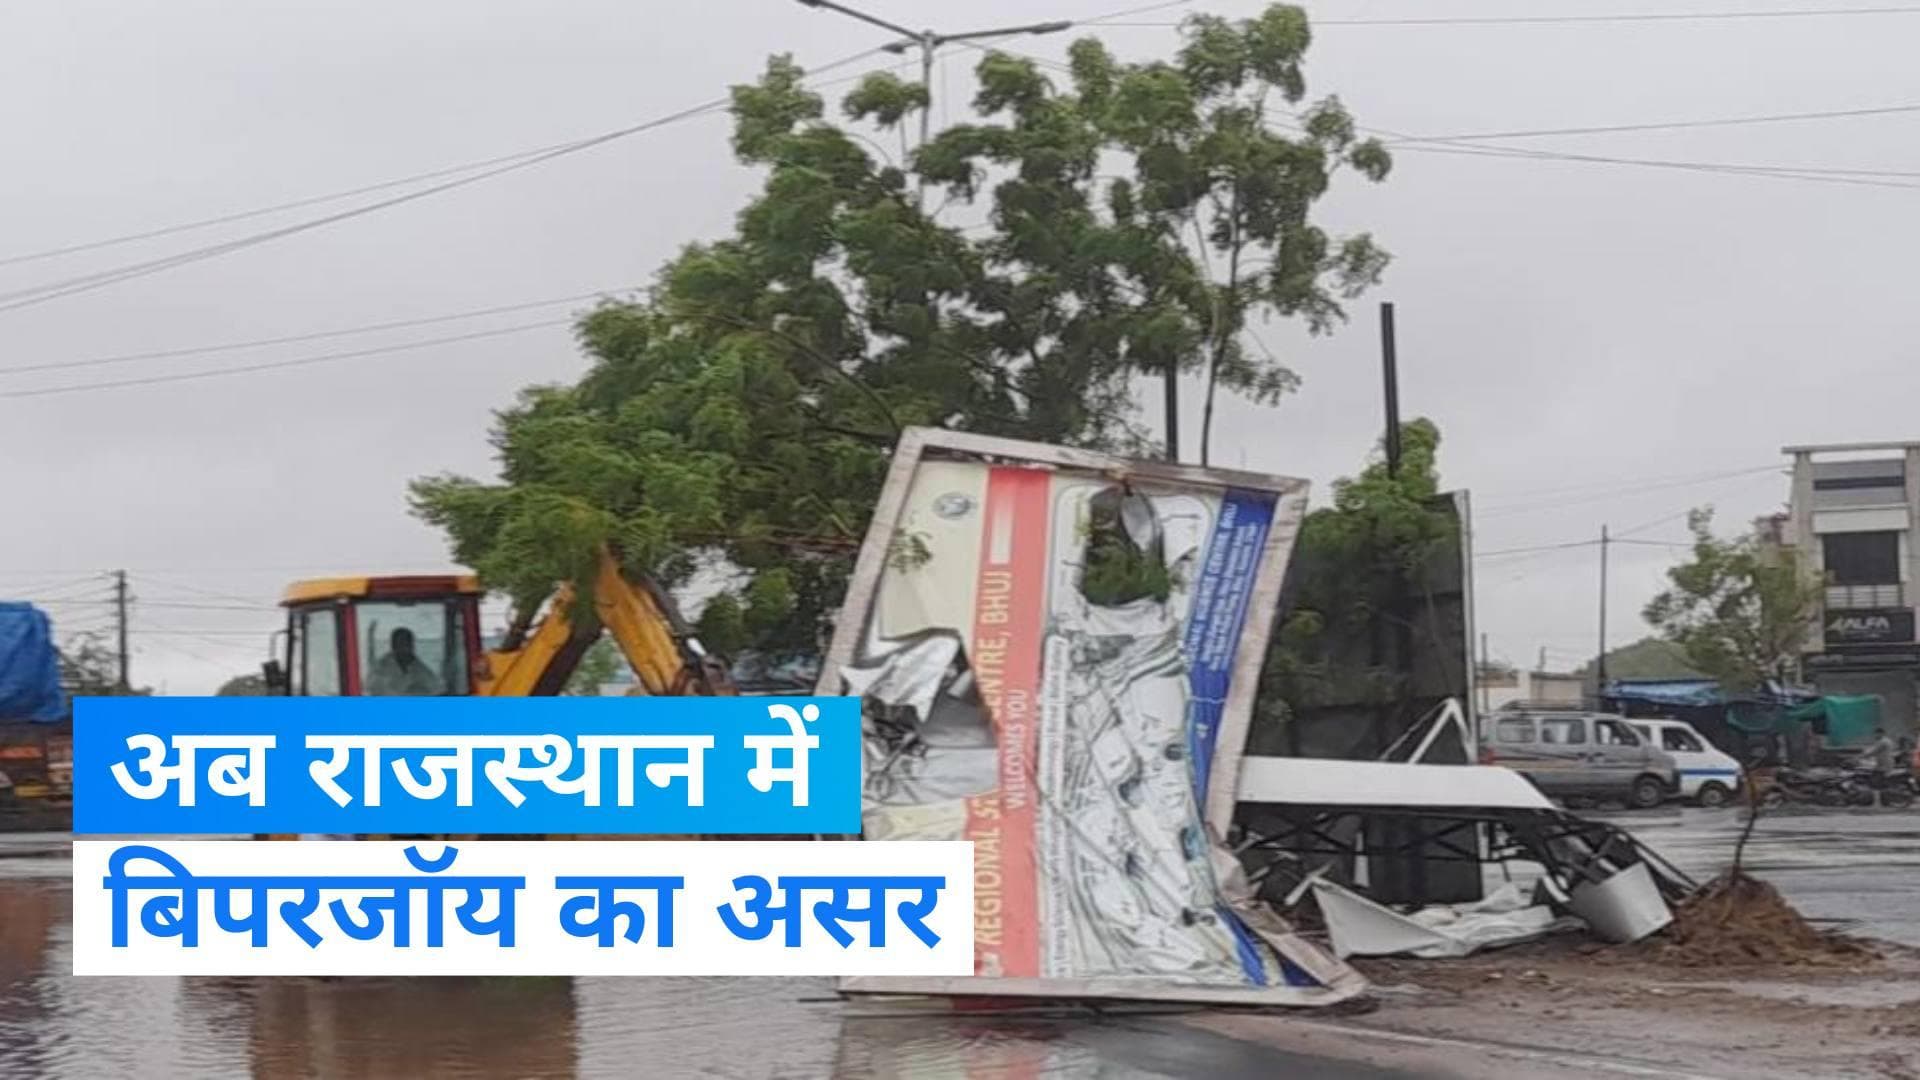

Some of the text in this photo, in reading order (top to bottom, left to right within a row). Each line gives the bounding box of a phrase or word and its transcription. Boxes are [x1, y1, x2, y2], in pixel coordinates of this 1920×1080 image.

[980, 570, 1013, 625] BHUJ
[1003, 688, 1028, 810] WELCOMES YOU
[970, 827, 1004, 945] REGIONAL
